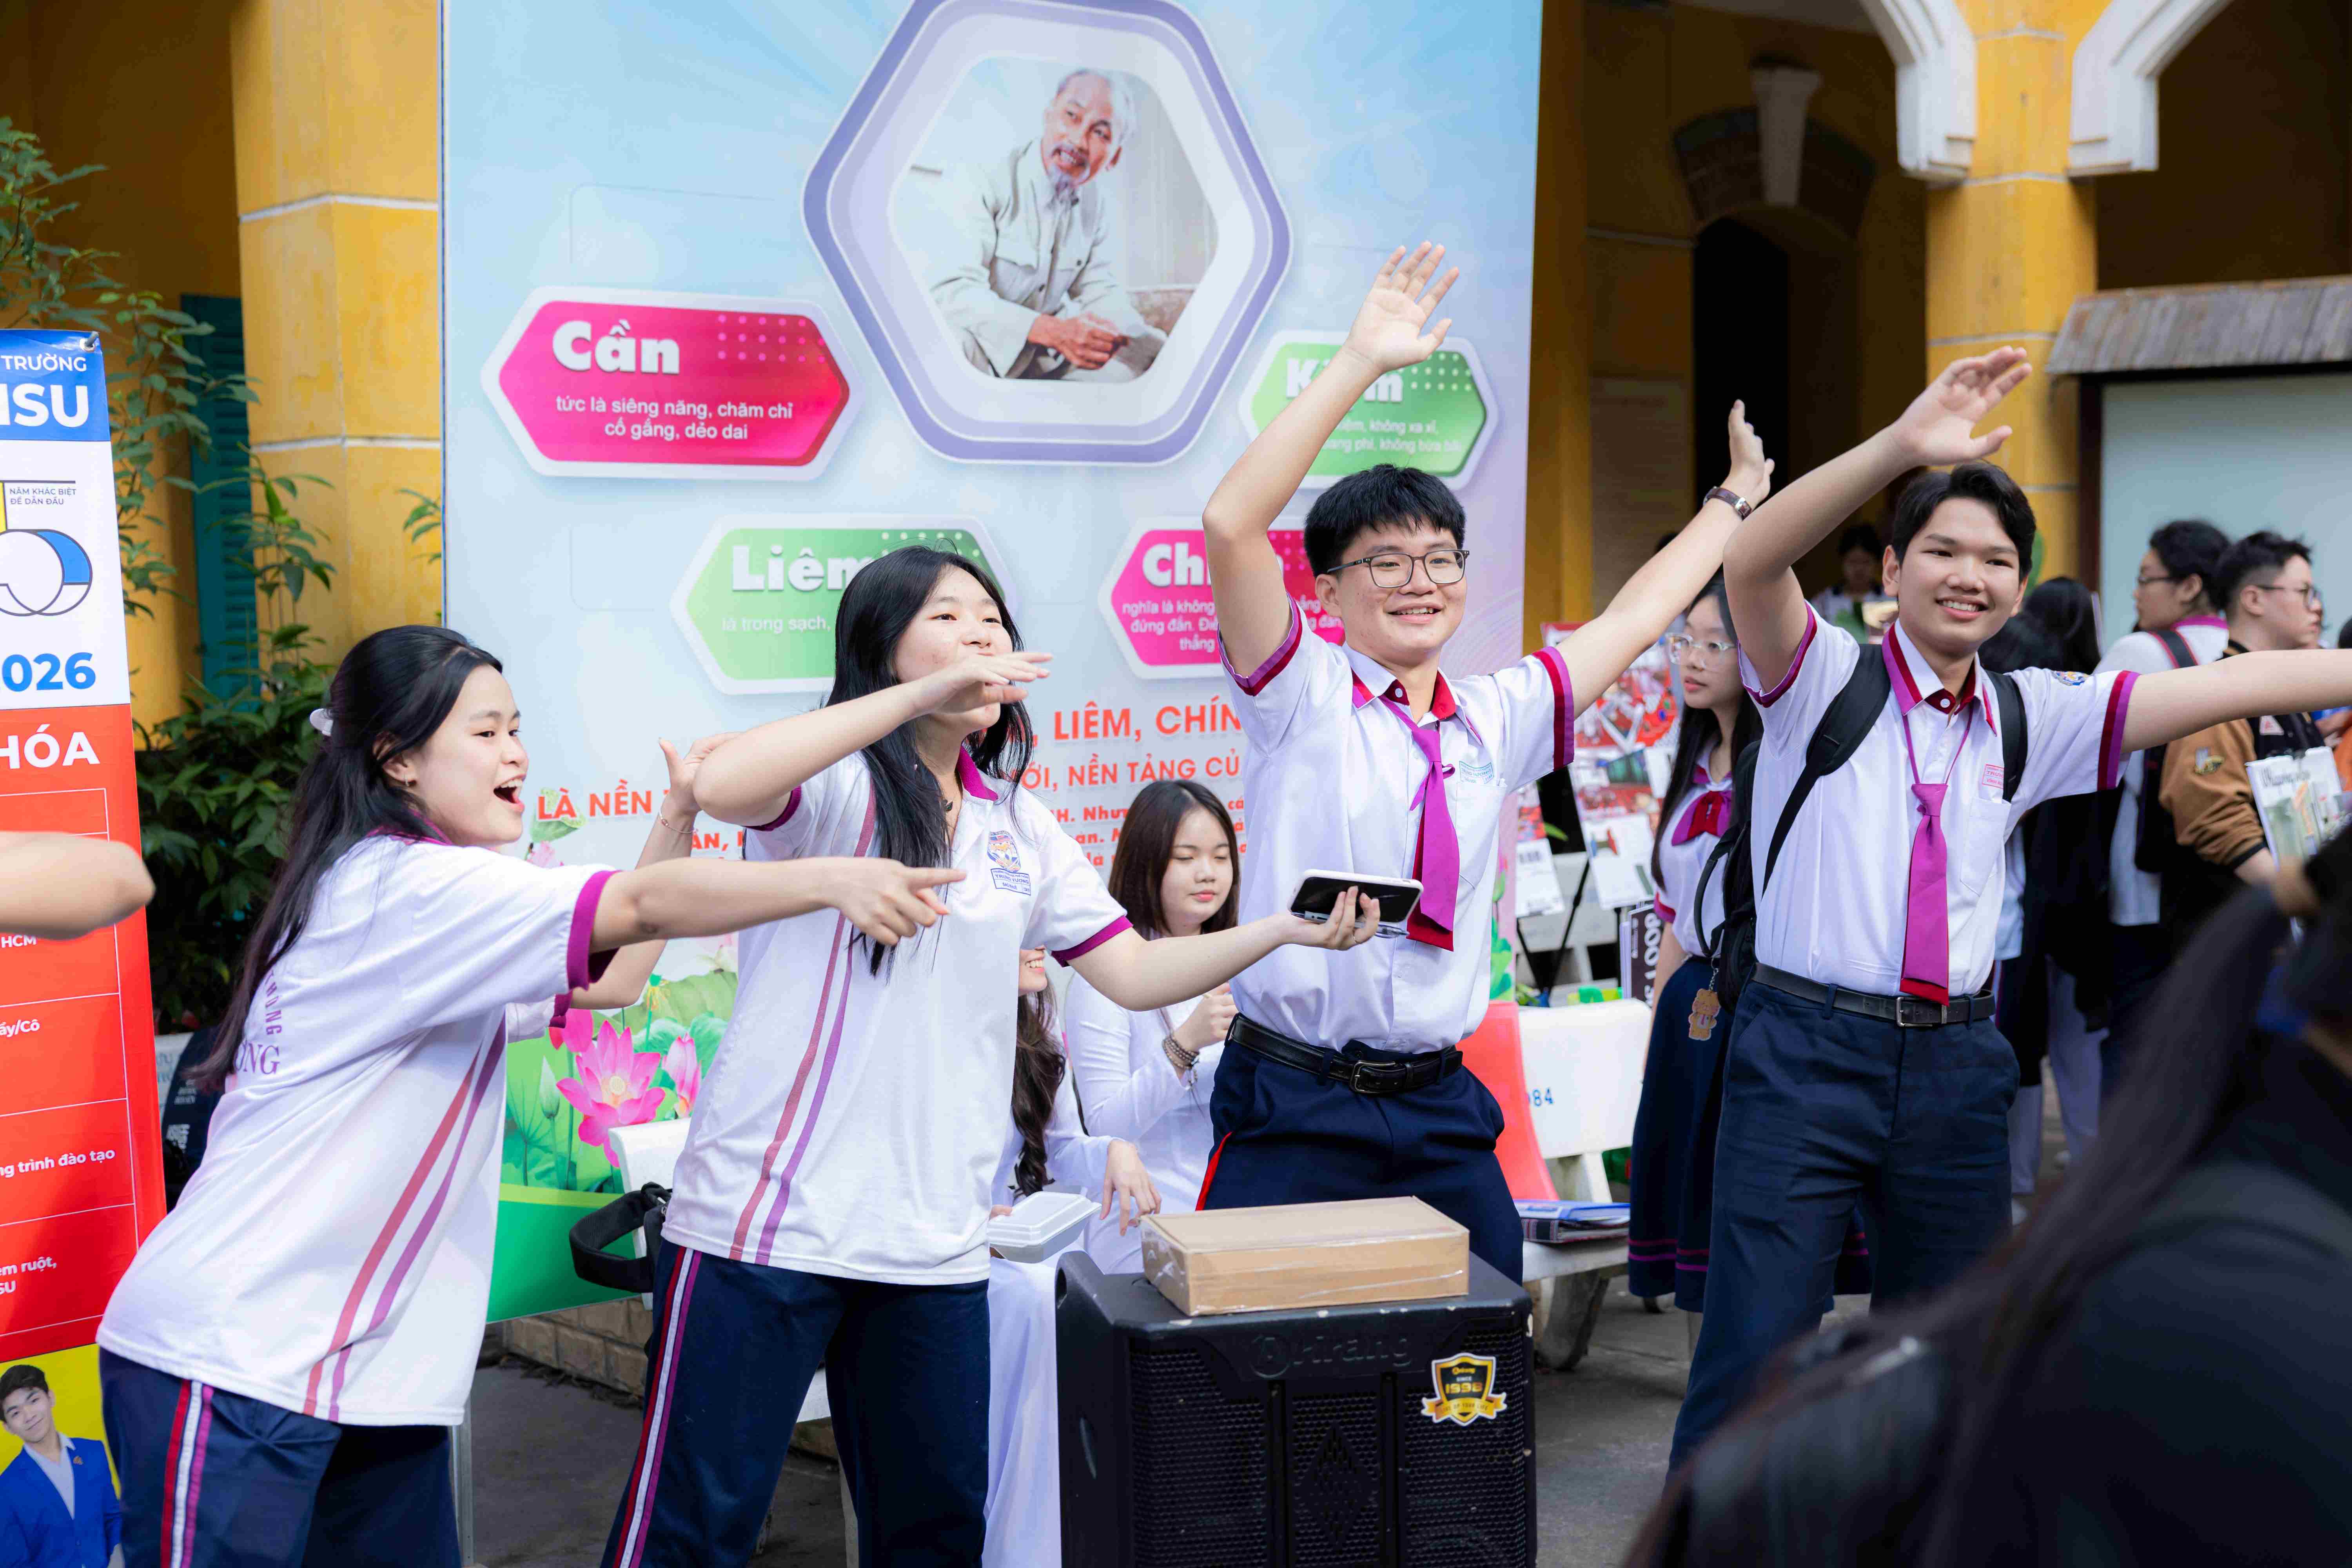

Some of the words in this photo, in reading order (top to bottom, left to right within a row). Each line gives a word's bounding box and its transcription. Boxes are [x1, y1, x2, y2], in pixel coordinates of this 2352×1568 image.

[552, 320, 679, 374] Cần
[4, 352, 87, 372] TRƯỜNG
[1286, 358, 1403, 403] Km
[0, 383, 89, 428] SU
[556, 396, 585, 412] tức
[590, 396, 606, 412] là
[612, 397, 658, 418] siêng
[665, 399, 712, 419] năng,
[717, 401, 763, 418] chăm
[768, 402, 793, 419] chỉ
[604, 419, 626, 436] cố
[631, 421, 679, 441] gắng,
[685, 422, 717, 439] dẻo
[722, 423, 748, 439] dai
[9, 487, 30, 495] NĂM
[58, 487, 76, 497] BIỆT
[1122, 600, 1159, 617] nghĩa
[1161, 601, 1174, 614] là
[1177, 599, 1215, 616] không
[741, 616, 783, 634] trong
[0, 652, 96, 692] 026
[1054, 701, 1141, 742] LIÊM,
[1156, 696, 1241, 735] CHÍN
[538, 788, 577, 820] LÀ
[589, 779, 652, 817] NỀN
[1016, 761, 1058, 792] ỚI,
[1069, 754, 1117, 787] NỀN
[1127, 754, 1196, 783] TẢNG
[1205, 748, 1240, 778] CỦ
[1, 935, 37, 948] HCM
[1528, 1087, 1554, 1106] 84
[18, 1156, 55, 1173] trình
[58, 1152, 87, 1167] đào
[90, 1149, 116, 1164] tạo
[21, 1256, 57, 1272] ruột,
[0, 1281, 16, 1294] SU
